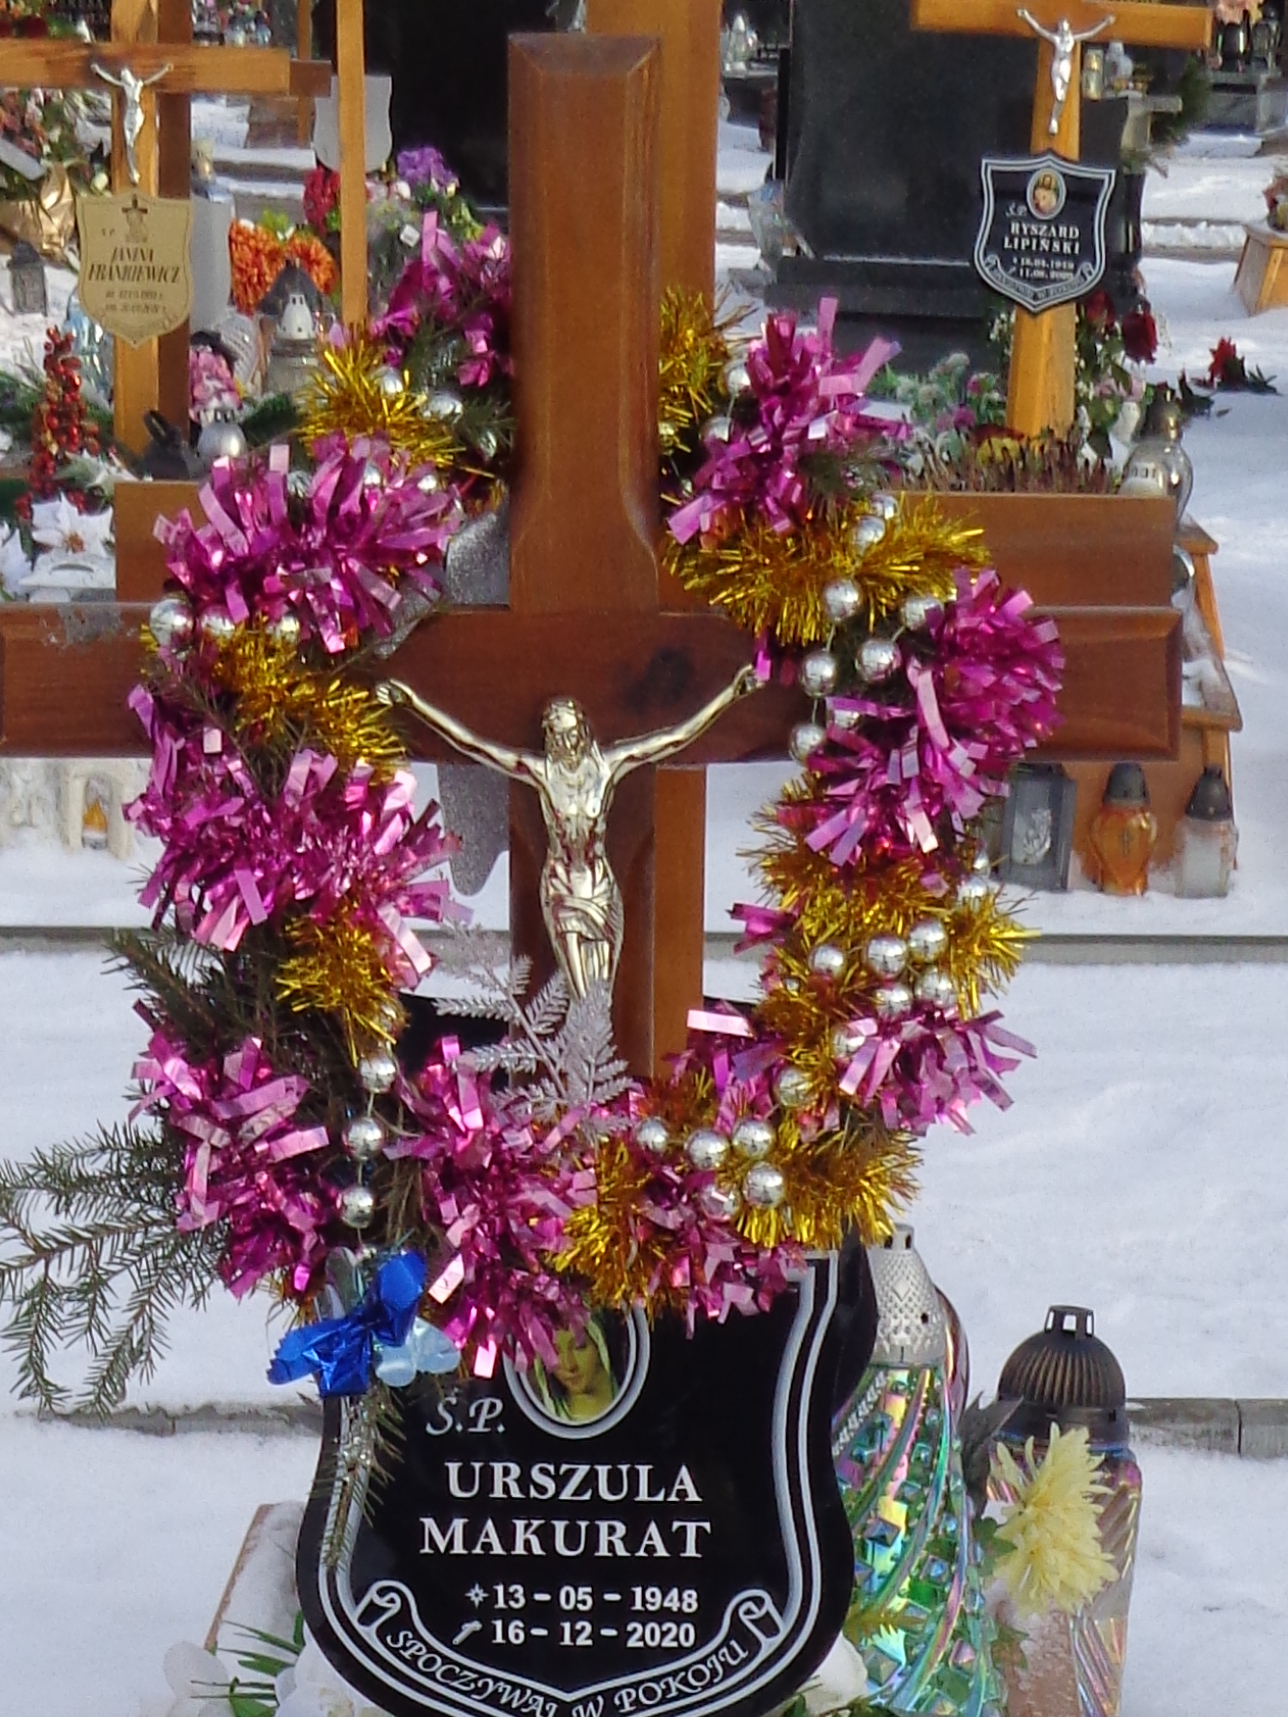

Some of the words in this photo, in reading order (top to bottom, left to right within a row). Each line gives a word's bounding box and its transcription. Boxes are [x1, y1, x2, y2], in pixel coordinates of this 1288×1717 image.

[1011, 221, 1080, 239] RYSZARD
[111, 247, 154, 262] JANINA
[88, 263, 181, 284] FRANKIEWICZ
[443, 1460, 704, 1502] URSZULA
[418, 1516, 712, 1558] MAKURAT
[613, 1639, 750, 1714] POKOJU
